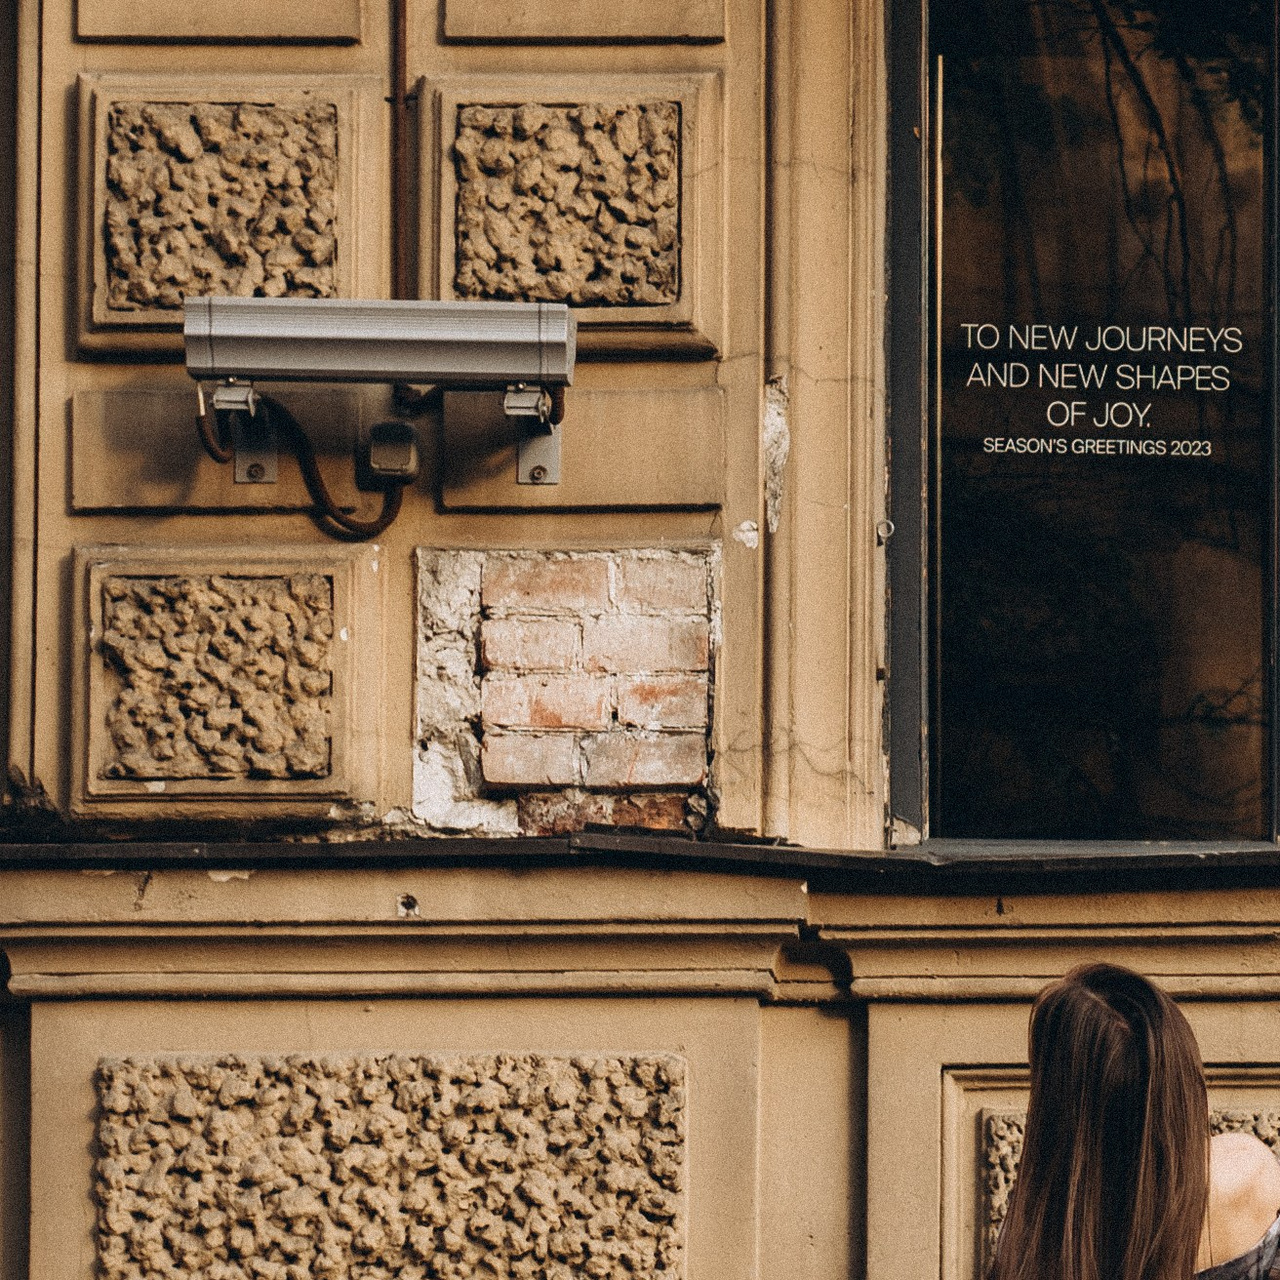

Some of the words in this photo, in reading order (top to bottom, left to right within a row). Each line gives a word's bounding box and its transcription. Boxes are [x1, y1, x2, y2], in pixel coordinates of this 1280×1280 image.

[961, 323, 999, 349] TO
[1009, 325, 1078, 350] NEW
[1085, 326, 1243, 353] JOURNEYS
[966, 362, 1029, 388] AND
[1039, 364, 1107, 389] NEW
[1115, 364, 1230, 391] SHAPES
[1046, 401, 1086, 427] OF
[1093, 402, 1151, 428] JOY.
[983, 437, 1067, 454] SEASON'S
[1072, 438, 1166, 455] GREETINGS
[1170, 440, 1212, 456] 2023
